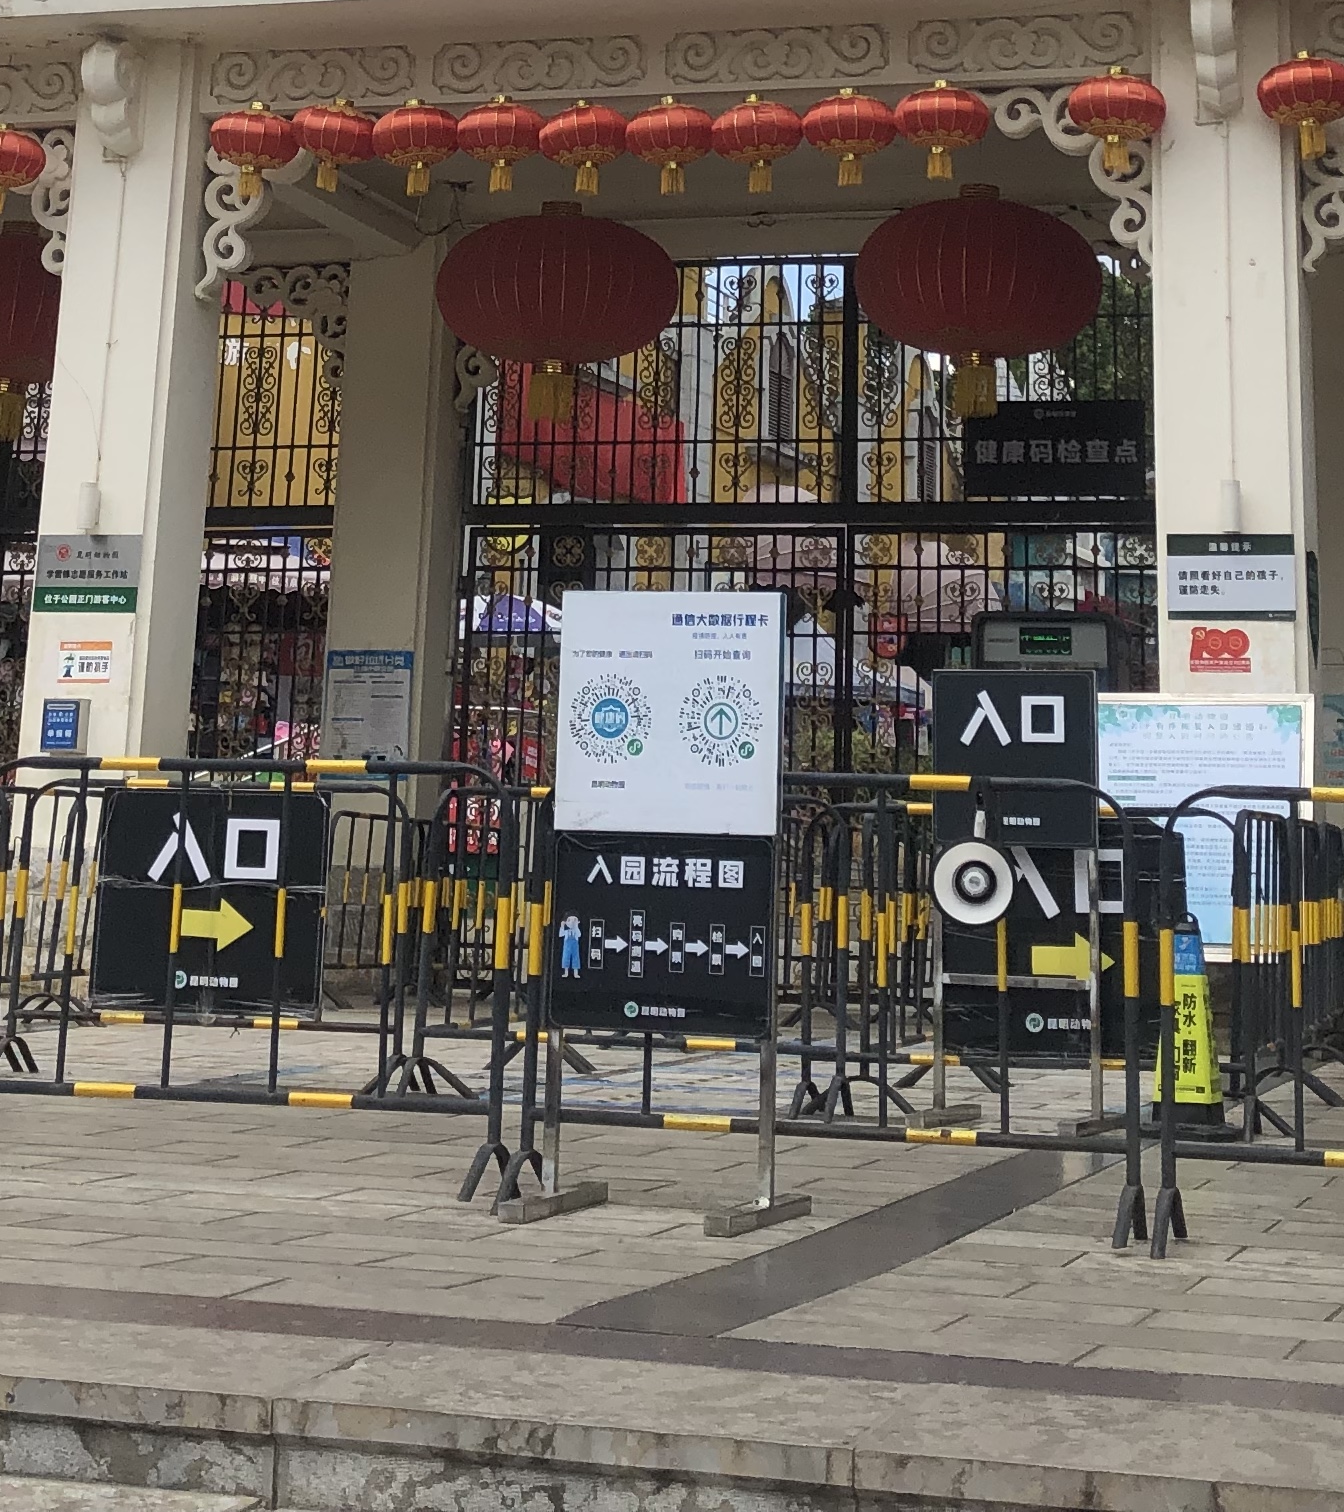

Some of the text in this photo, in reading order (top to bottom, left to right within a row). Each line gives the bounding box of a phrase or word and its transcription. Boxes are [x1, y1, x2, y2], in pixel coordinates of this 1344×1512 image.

[974, 439, 1139, 465] 健康码检查点
[44, 594, 127, 605] 位于公园正门游客中心
[671, 613, 769, 627] 通信大数据行程卡
[694, 649, 752, 660] 扫码开始查询
[960, 690, 1065, 747] 入口
[147, 811, 281, 884] 入口
[586, 854, 744, 889] 入园流程图
[1047, 1018, 1093, 1030] 昆明动物
